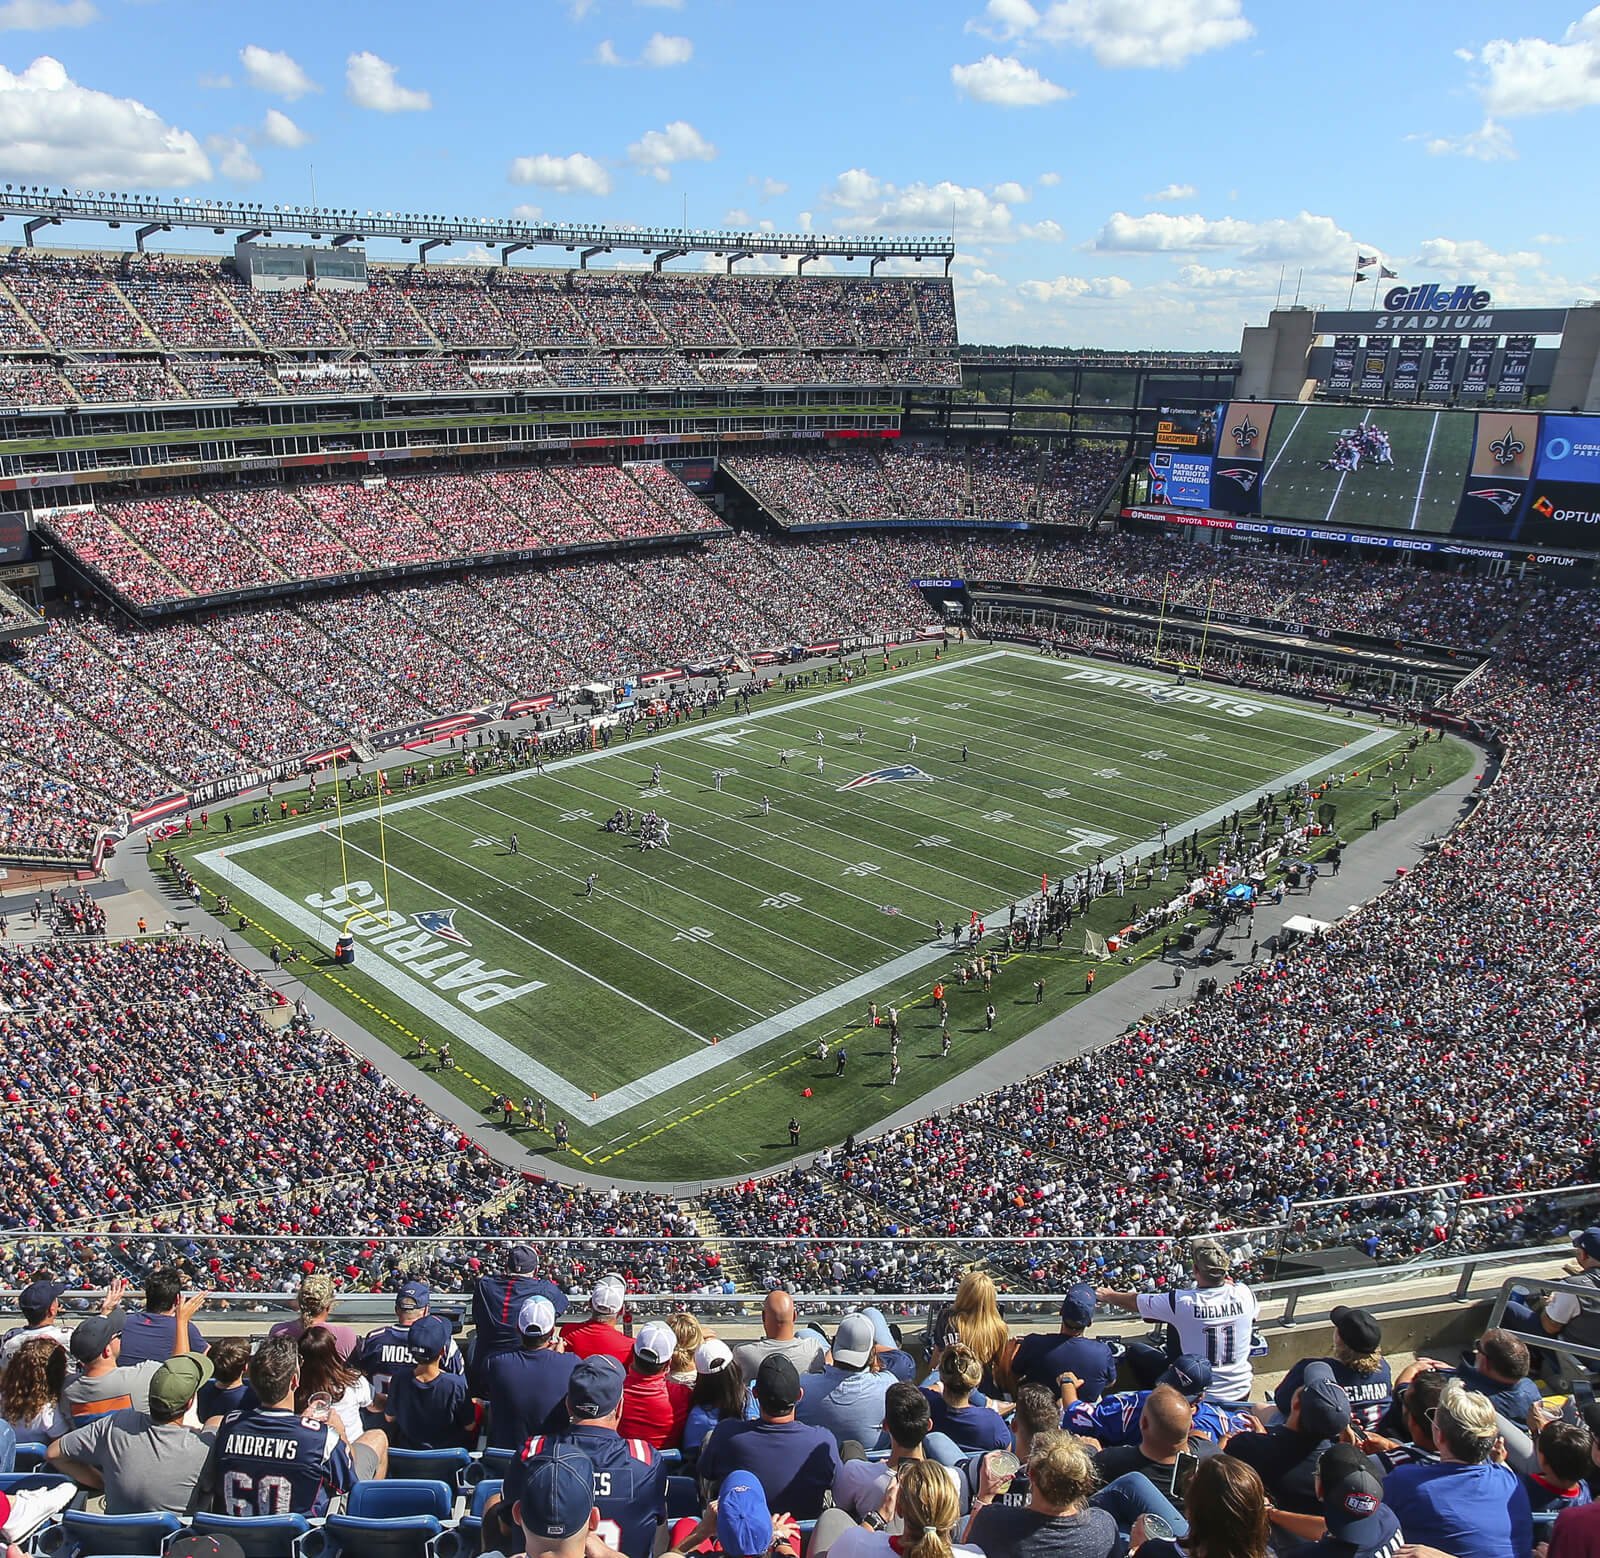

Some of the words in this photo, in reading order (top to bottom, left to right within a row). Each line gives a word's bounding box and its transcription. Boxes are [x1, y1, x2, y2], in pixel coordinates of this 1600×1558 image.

[1384, 284, 1490, 312] Gillette
[1375, 315, 1493, 328] STADIUM
[203, 462, 224, 473] SAINTS
[1173, 463, 1194, 471] MADE
[1195, 464, 1210, 472] FOR
[1172, 470, 1207, 478] PATRIOTS
[1172, 476, 1210, 484] WATCHING
[1138, 512, 1166, 521] Putnam
[1176, 516, 1202, 525] TOYOTA
[1206, 520, 1233, 529] TOYOTA
[1236, 522, 1268, 533] GEICO
[1273, 526, 1306, 537] GEICO
[1311, 530, 1346, 541] GEICO
[1351, 535, 1388, 546] GEICO
[1393, 539, 1431, 550] GEICO
[518, 552, 533, 560] 7:31
[1461, 547, 1504, 559] EMPOWER
[465, 558, 474, 566] 25
[1537, 554, 1574, 566] OPTUM
[1123, 597, 1129, 606] 0
[1170, 605, 1175, 613] 7
[1217, 612, 1226, 620] 10
[1240, 616, 1250, 624] 25
[1284, 623, 1304, 634] 7:31
[1317, 629, 1330, 638] 40
[1402, 646, 1424, 655] OPTUM
[1356, 650, 1441, 668] OPTUM
[1456, 654, 1478, 663] OPTUM
[1062, 671, 1264, 718] PATRIOTS
[193, 784, 214, 803] NEW
[217, 772, 259, 796] ENGLAND
[262, 758, 302, 782] PATRIOTS
[981, 810, 1015, 822] 50
[919, 834, 951, 848] 40
[844, 861, 880, 876] 30
[763, 891, 803, 908] 20
[676, 926, 714, 942] 10
[304, 880, 548, 1012] PATRIOTS
[1194, 1302, 1243, 1319] EDELMAN
[1202, 1323, 1236, 1366] 11
[381, 1344, 418, 1364] MOS
[225, 1434, 298, 1460] ANDREWS
[224, 1471, 292, 1517] 60
